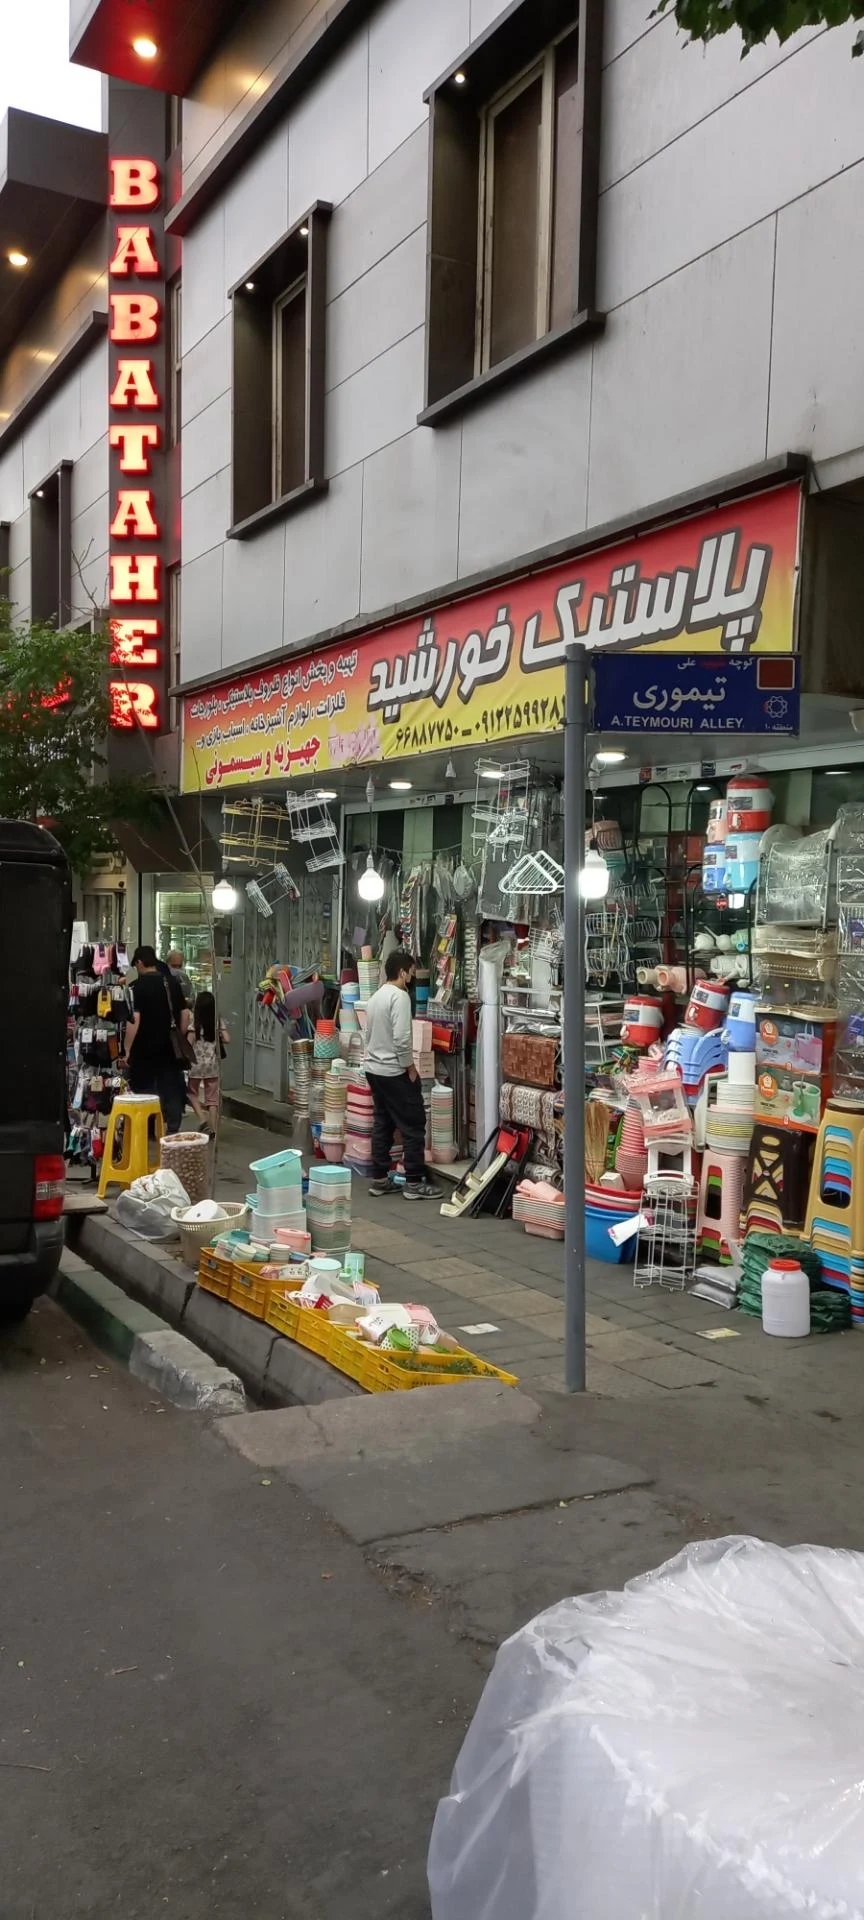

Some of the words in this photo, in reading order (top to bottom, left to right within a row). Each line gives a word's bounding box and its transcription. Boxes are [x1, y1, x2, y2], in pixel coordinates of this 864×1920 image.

[108, 159, 158, 729] BABATAHER
[520, 527, 772, 673] پلاستیک
[302, 660, 328, 691] پخش
[328, 661, 335, 682] و
[337, 649, 358, 677] تهیه
[367, 604, 512, 724] خورشید
[677, 657, 697, 670] علی
[728, 657, 755, 670] کوچه
[254, 674, 281, 702] ظروف
[281, 667, 302, 699] انواع
[633, 677, 727, 711] تیموری
[287, 700, 311, 733] لوازم
[316, 690, 346, 720] فلزات
[222, 718, 246, 744] اسباب
[611, 715, 694, 729] A.TEYMOURI
[205, 750, 263, 785] سیسمونی
[264, 750, 272, 775] و
[274, 737, 321, 772] جهیزیه
